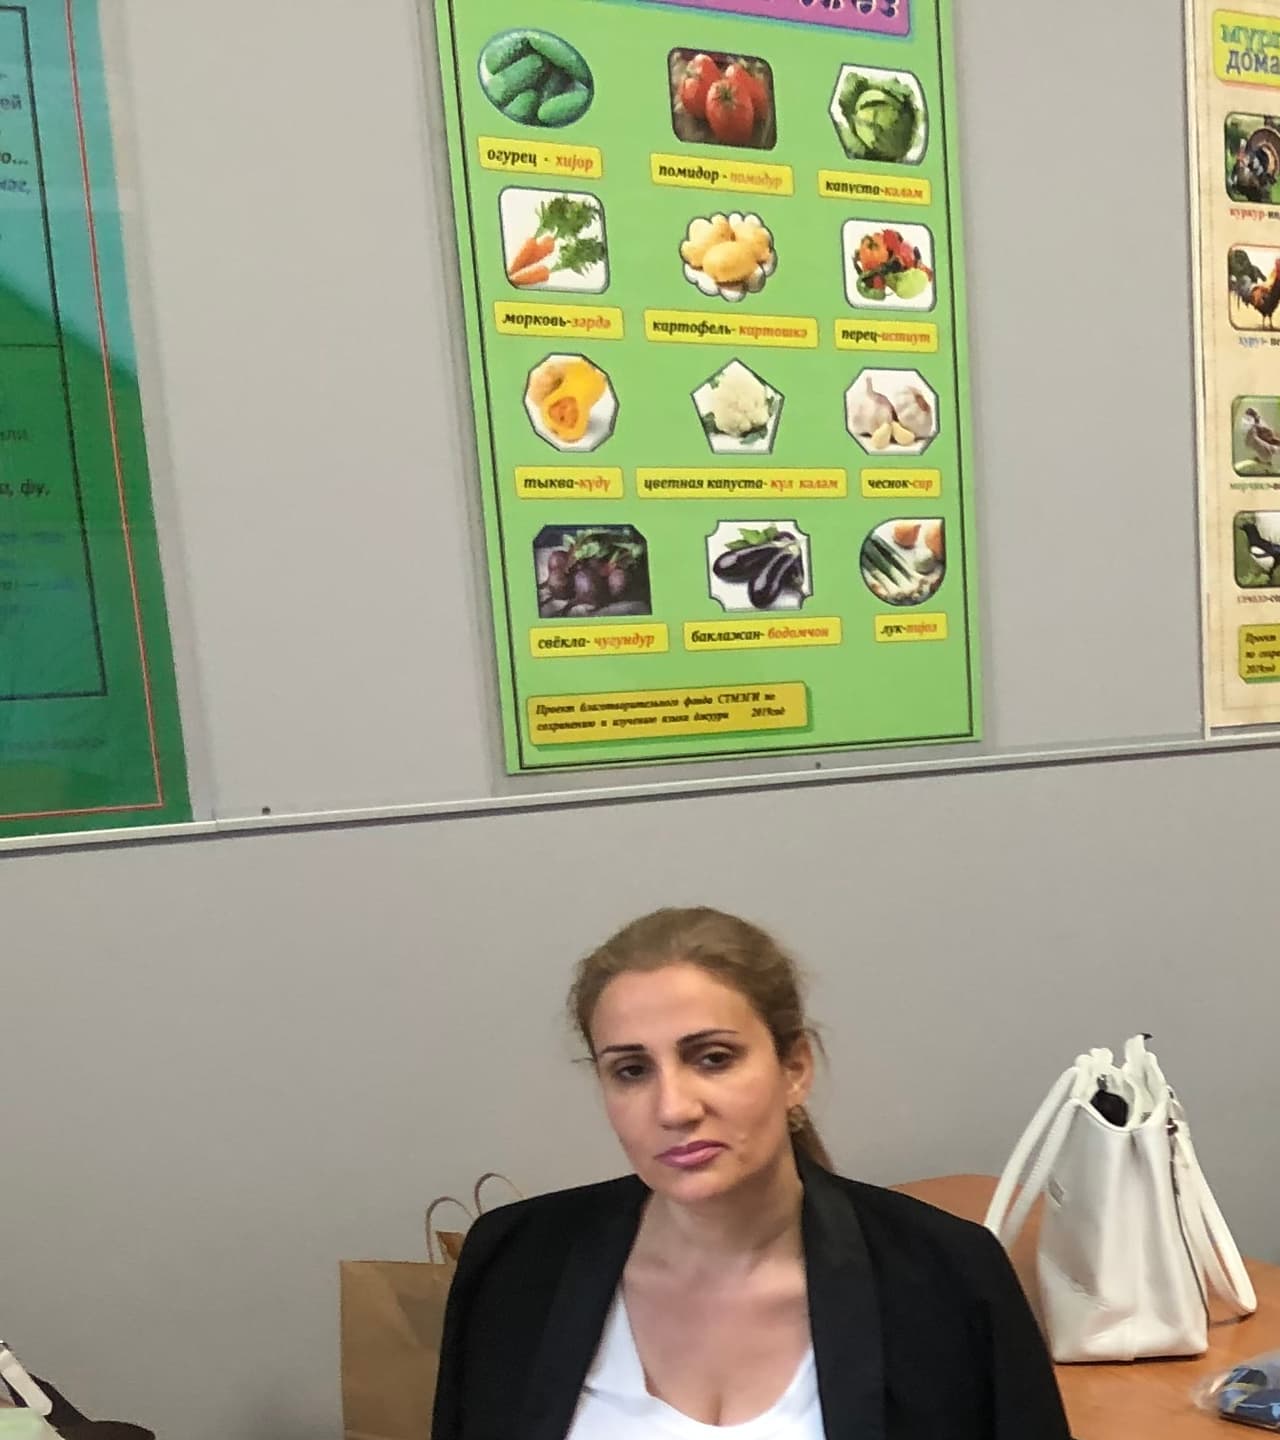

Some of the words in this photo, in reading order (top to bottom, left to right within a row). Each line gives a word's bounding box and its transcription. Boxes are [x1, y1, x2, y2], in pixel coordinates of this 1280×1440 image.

[488, 146, 537, 166] огурец
[659, 165, 719, 183] помидор
[644, 478, 704, 492] цветная
[538, 634, 590, 649] свёкла-
[691, 629, 765, 643] баклажан-
